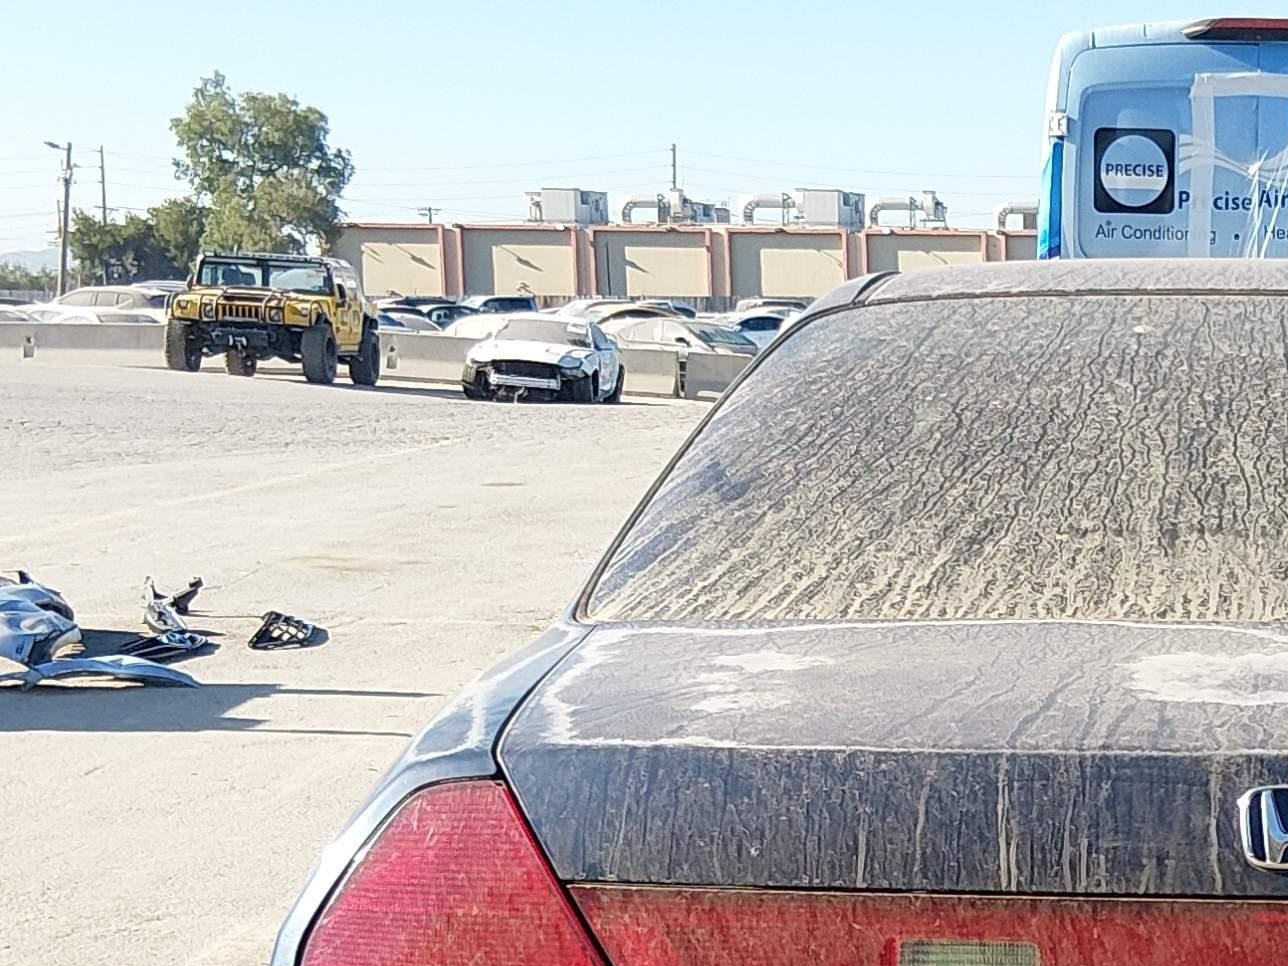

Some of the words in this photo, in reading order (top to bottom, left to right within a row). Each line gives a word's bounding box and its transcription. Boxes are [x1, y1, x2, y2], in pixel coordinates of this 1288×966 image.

[1105, 163, 1164, 177] PRECISE
[1178, 190, 1252, 211] Pcise
[1095, 224, 1118, 239] Air
[1121, 223, 1217, 245] Conditiong
